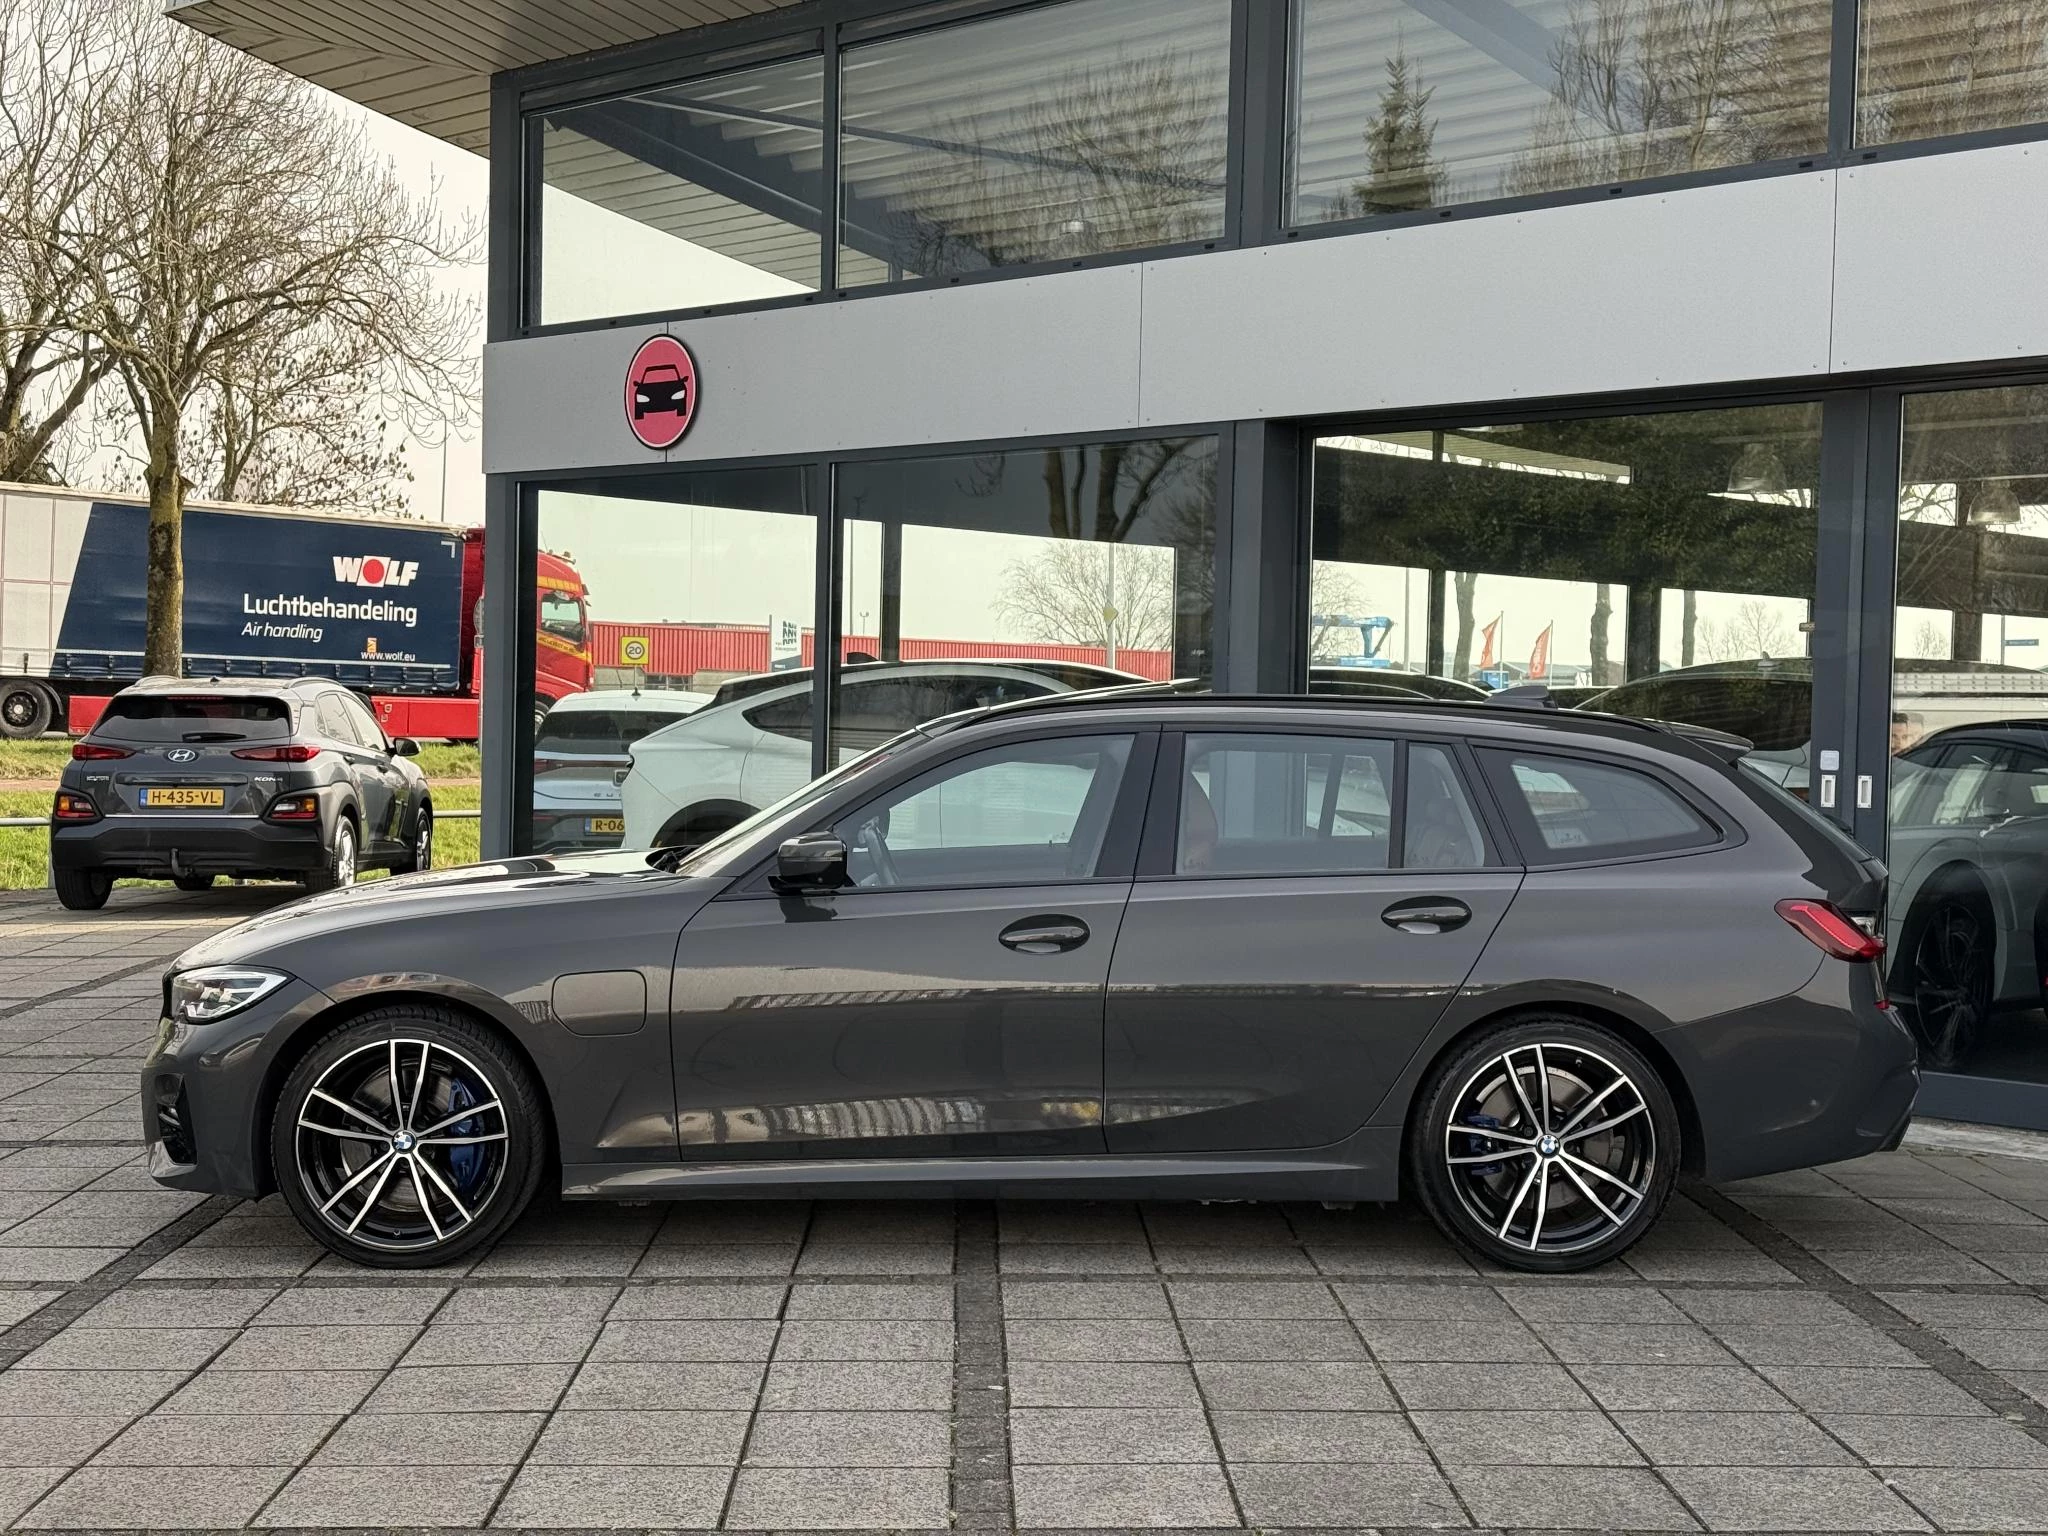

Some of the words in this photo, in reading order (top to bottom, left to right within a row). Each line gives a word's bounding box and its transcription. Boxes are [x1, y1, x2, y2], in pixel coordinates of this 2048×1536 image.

[333, 556, 419, 587] WOLF
[244, 593, 417, 627] Luchtbehandeling
[241, 622, 262, 636] Air
[264, 622, 323, 642] handling
[361, 651, 415, 662] www.wolf.eu
[628, 646, 642, 655] 20
[152, 791, 218, 803] H-435-VL
